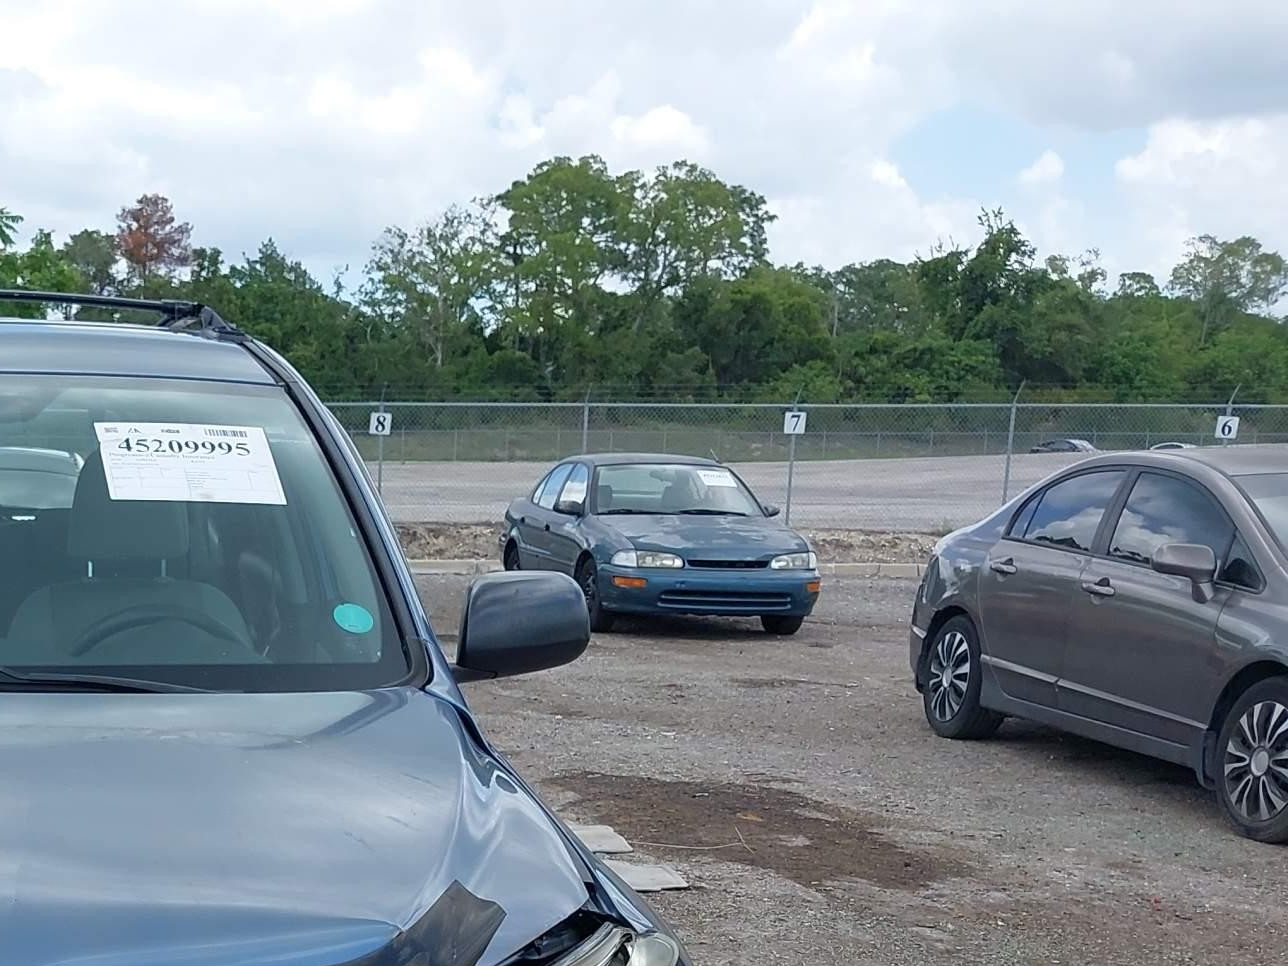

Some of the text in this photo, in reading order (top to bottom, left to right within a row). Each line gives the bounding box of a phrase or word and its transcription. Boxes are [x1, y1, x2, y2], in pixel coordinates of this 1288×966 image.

[375, 415, 386, 432] 8
[790, 414, 801, 432] 7
[1221, 418, 1234, 436] 6
[118, 437, 251, 456] 45209995
